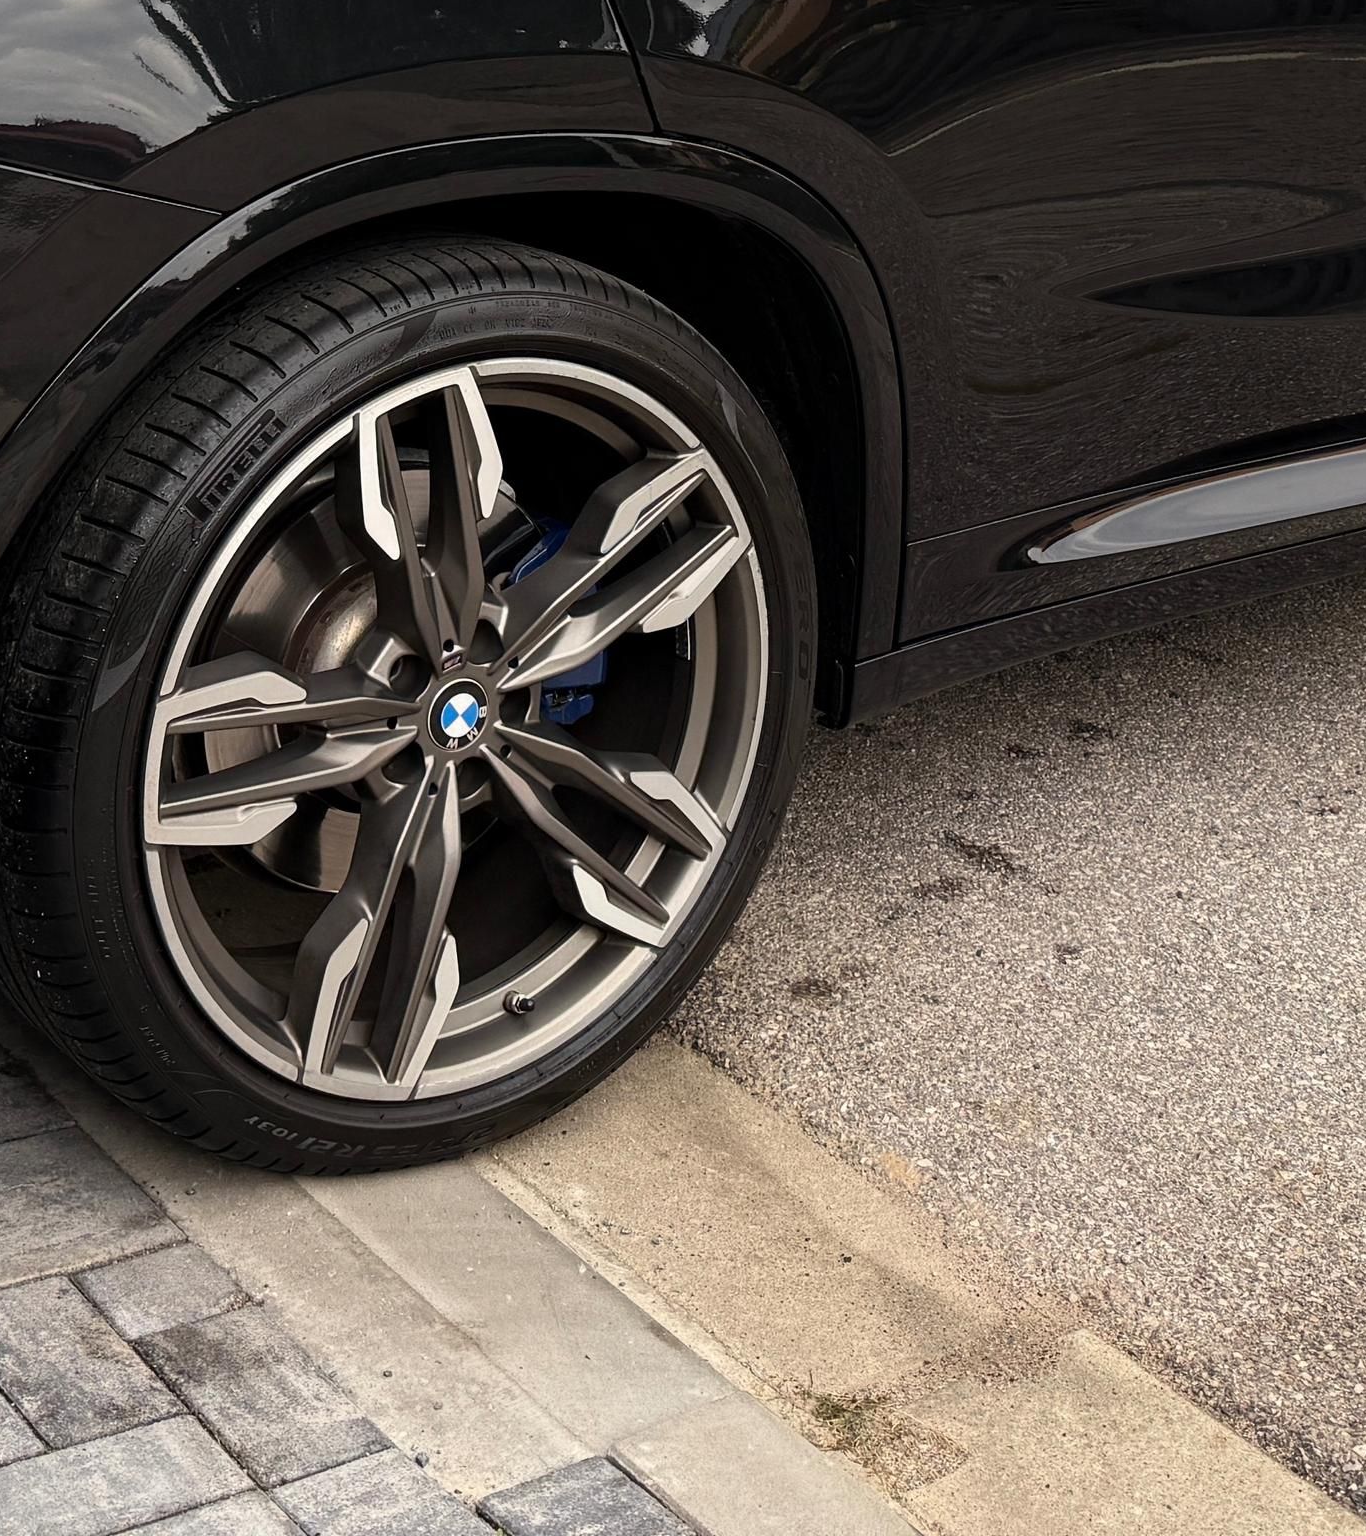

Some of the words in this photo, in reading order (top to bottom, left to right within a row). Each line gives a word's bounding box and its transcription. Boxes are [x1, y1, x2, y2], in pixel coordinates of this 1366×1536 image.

[184, 408, 288, 523] PIRELLI
[445, 705, 489, 750] BMW
[243, 1115, 294, 1142] 103Y
